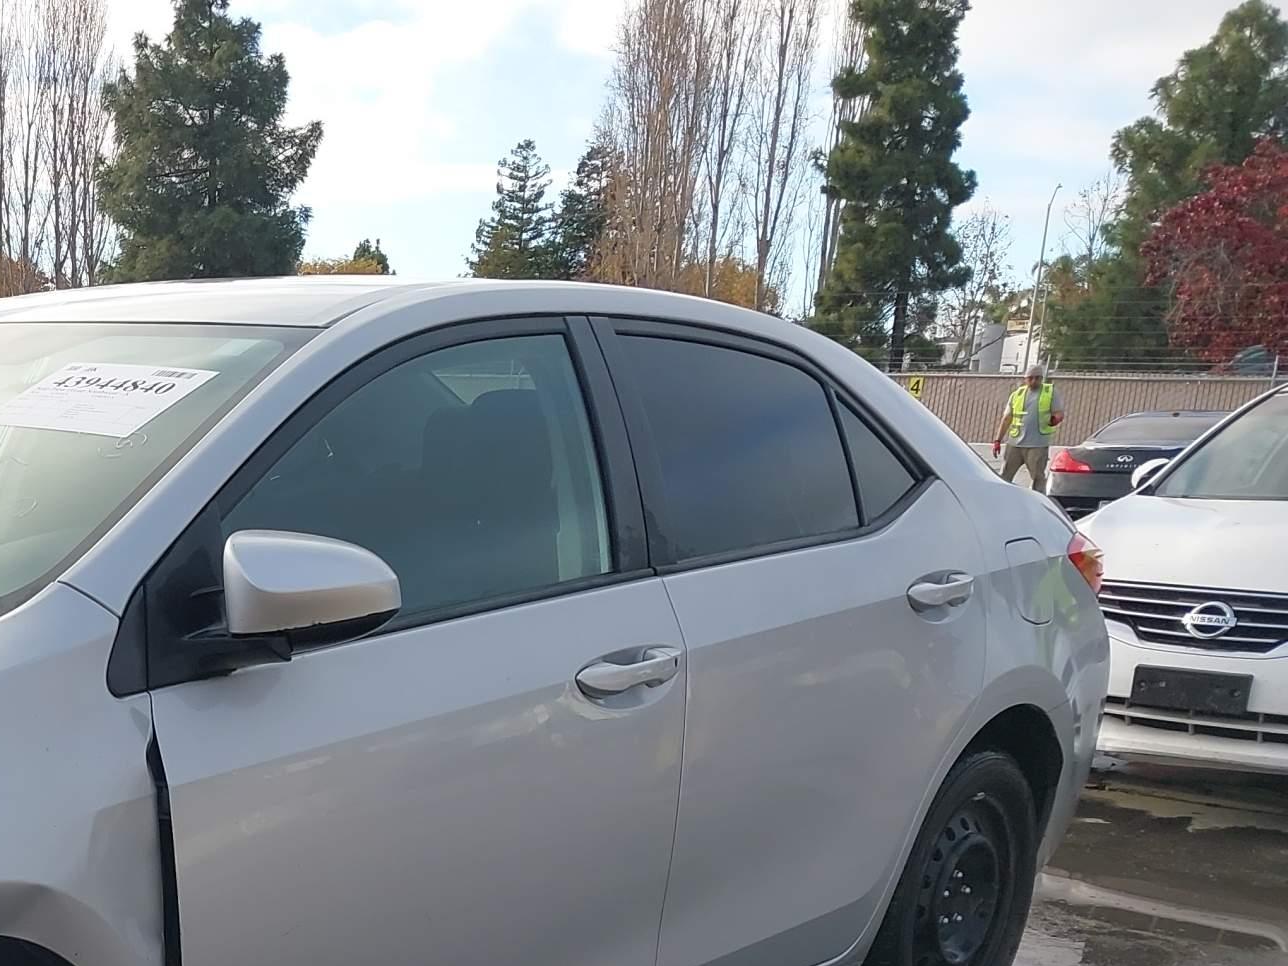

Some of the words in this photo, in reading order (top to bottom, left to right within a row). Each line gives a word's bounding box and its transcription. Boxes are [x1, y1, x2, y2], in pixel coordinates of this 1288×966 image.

[53, 375, 176, 395] 43944840
[910, 379, 921, 395] 4
[1190, 614, 1230, 625] NISSAN
